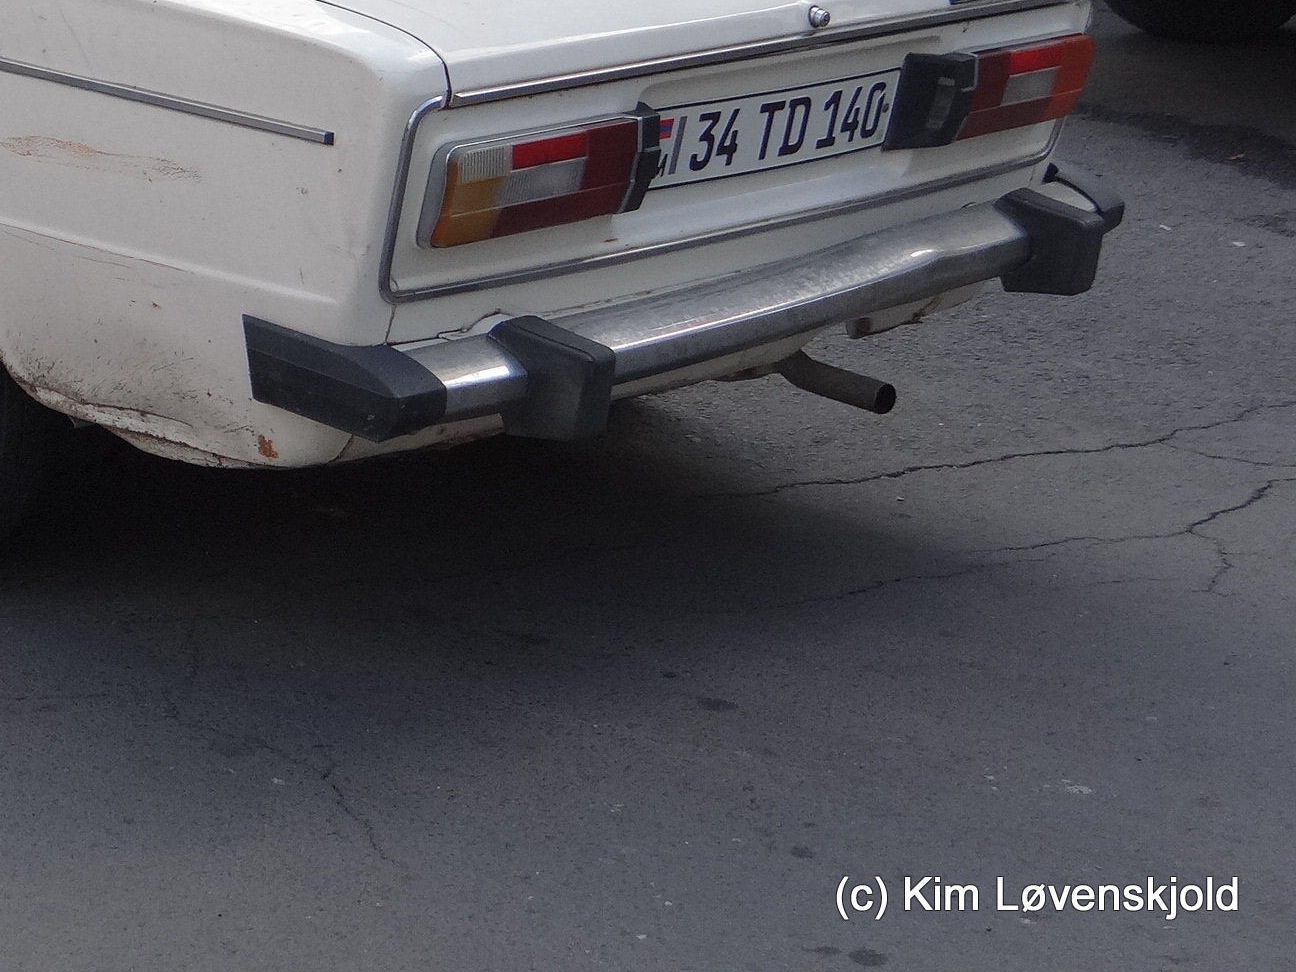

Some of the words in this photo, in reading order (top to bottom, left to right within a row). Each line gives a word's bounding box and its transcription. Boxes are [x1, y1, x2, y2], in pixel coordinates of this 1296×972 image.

[688, 108, 741, 172] 34
[758, 96, 812, 161] TD
[815, 81, 886, 150] 140
